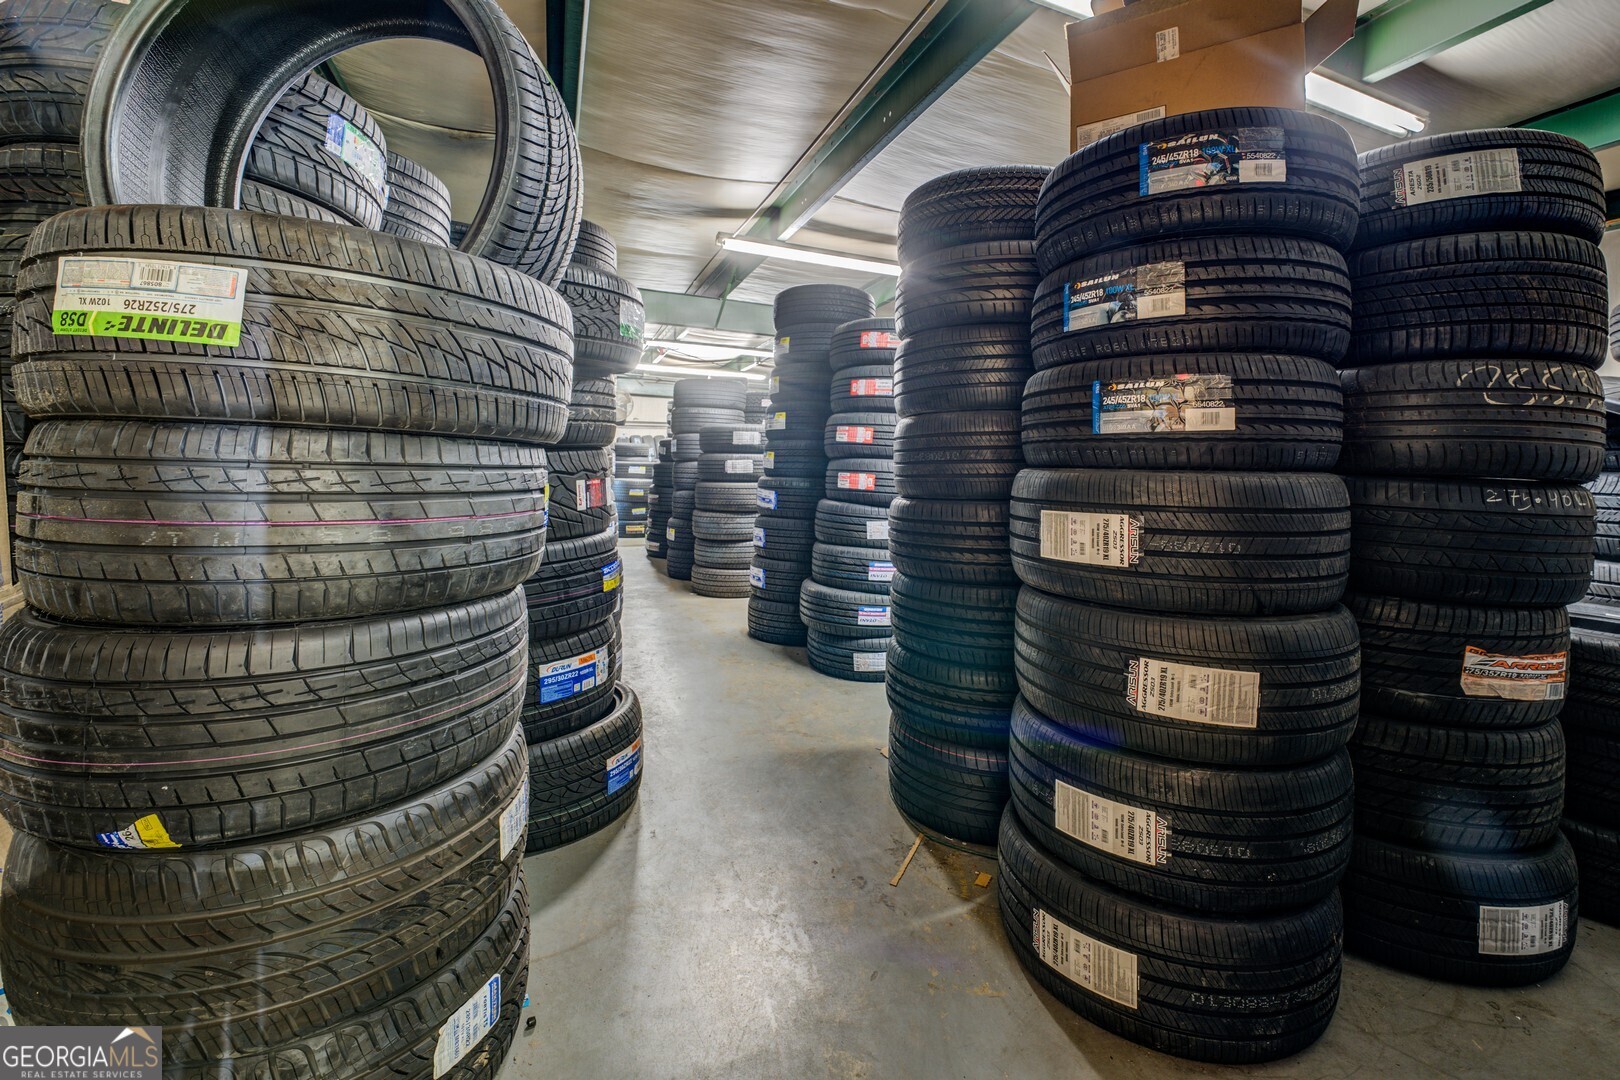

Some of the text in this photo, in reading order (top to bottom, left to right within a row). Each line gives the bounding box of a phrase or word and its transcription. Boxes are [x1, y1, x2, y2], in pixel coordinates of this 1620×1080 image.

[1167, 133, 1219, 148] SAILUN
[1151, 148, 1200, 165] 245/45ZR18
[1408, 170, 1416, 196] ARESTA
[1081, 274, 1120, 288] SAILUN
[78, 297, 111, 306] 102W XL
[123, 299, 197, 315] 275/25ZR26
[60, 312, 88, 327] DS8
[118, 315, 229, 340] DELINTE
[1117, 381, 1165, 390] SAILUN
[1102, 395, 1146, 405] 245/45ZR18
[1130, 518, 1139, 564] ARISUN
[543, 671, 579, 685] 295/30ZR22
[1126, 660, 1139, 706] ARISUN
[1141, 660, 1149, 711] AGGRESSOR
[1157, 816, 1167, 864] ARISUN
